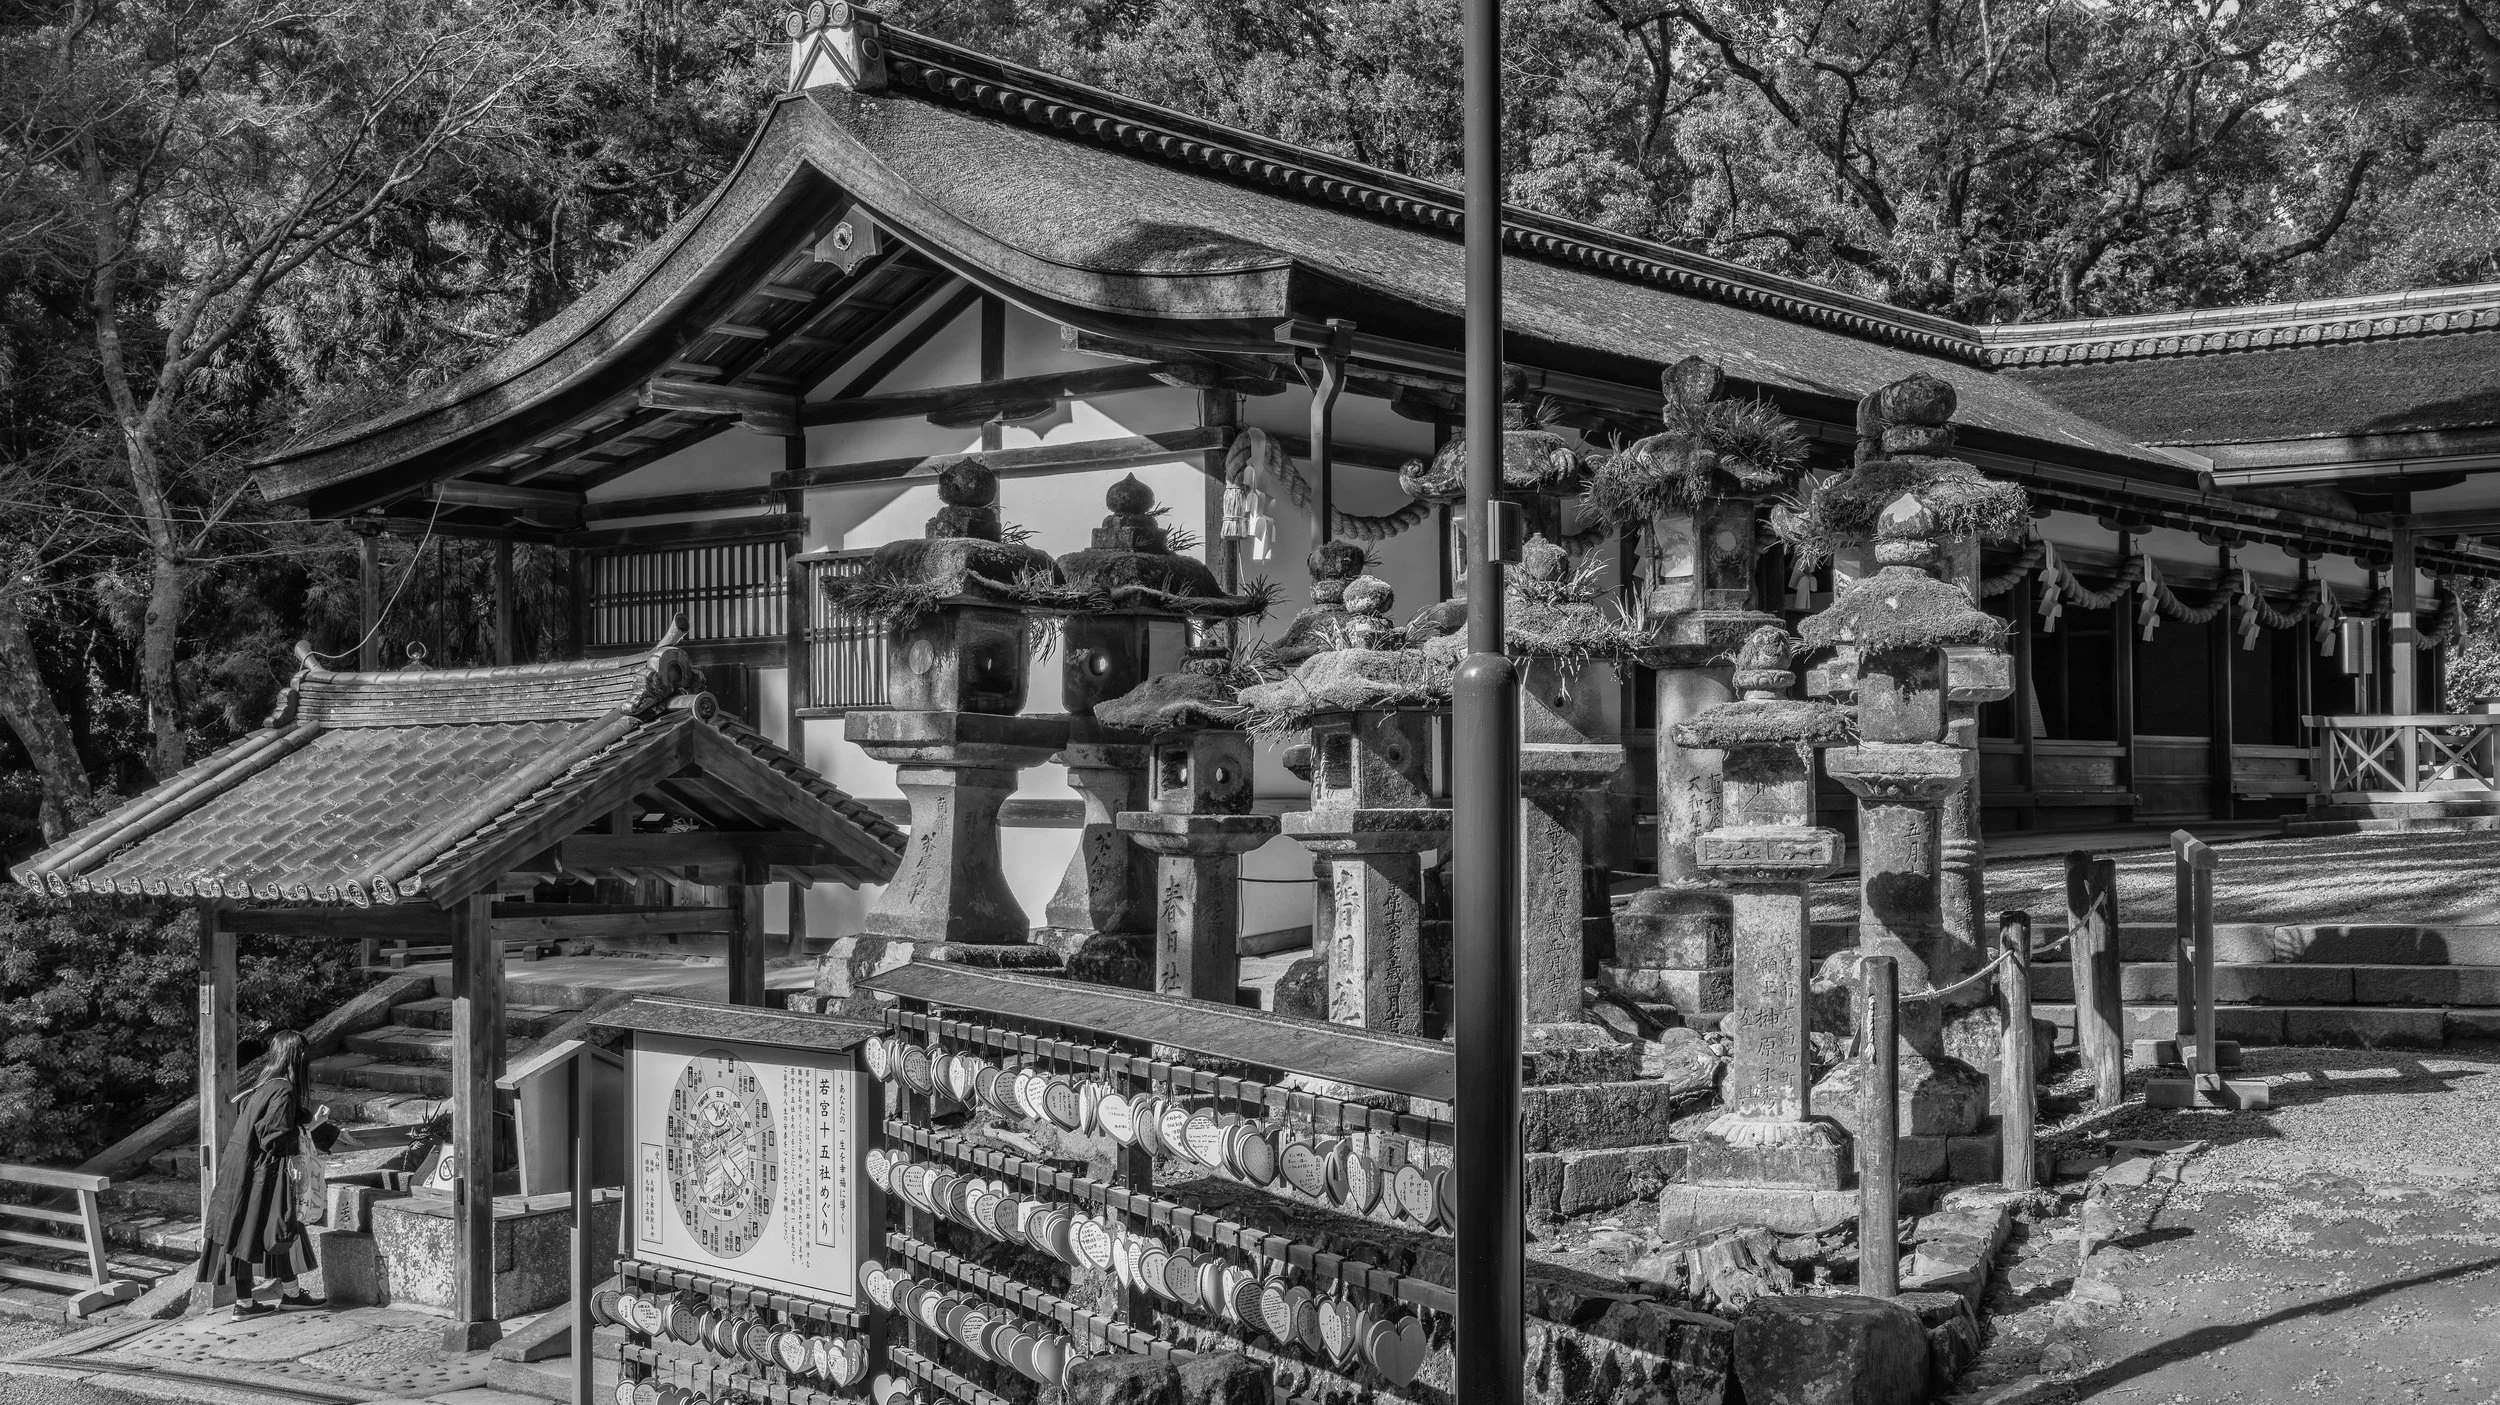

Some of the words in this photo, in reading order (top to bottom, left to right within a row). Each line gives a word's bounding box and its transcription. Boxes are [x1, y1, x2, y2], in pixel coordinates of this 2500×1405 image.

[1160, 874, 1186, 993] 春日社
[819, 1078, 831, 1237] 若宮十五社めぐり
